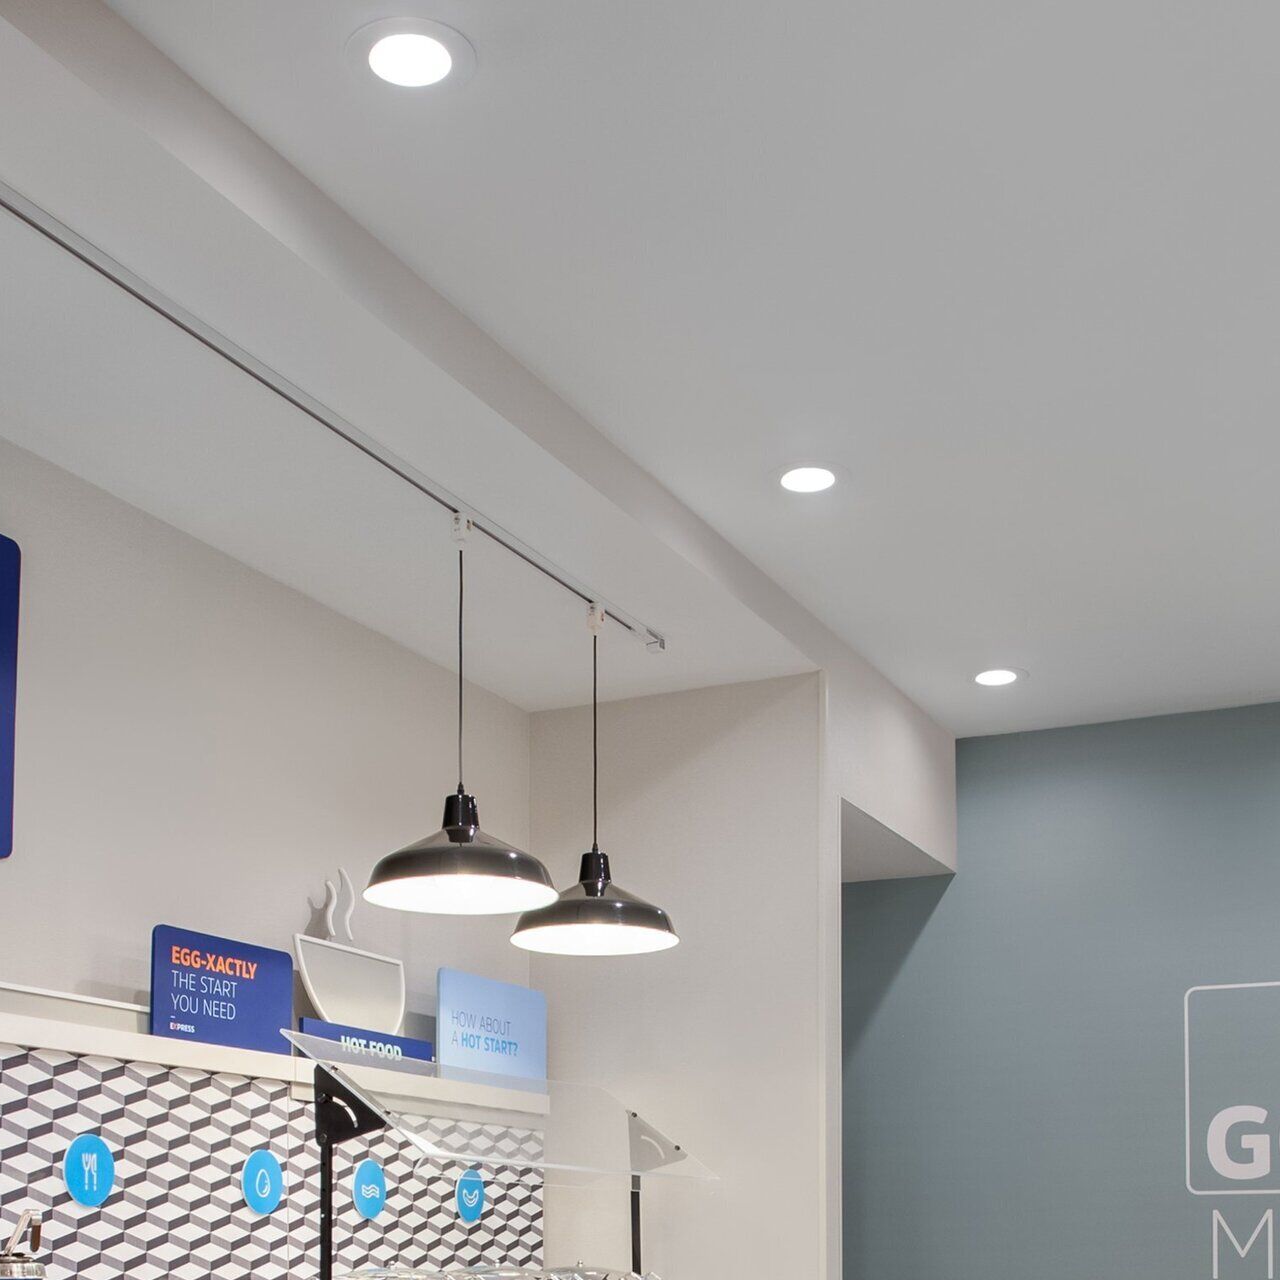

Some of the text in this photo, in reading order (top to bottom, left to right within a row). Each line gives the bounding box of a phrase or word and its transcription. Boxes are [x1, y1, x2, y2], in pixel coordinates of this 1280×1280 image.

[171, 945, 257, 980] EGG-XACTLY
[171, 969, 238, 999] THE START
[171, 993, 236, 1020] YOU NEED
[169, 1022, 196, 1034] EXPRESS
[451, 1010, 512, 1037] HOW ABOUT
[340, 1035, 402, 1061] HOT FOOD
[451, 1031, 520, 1057] A HOT START?
